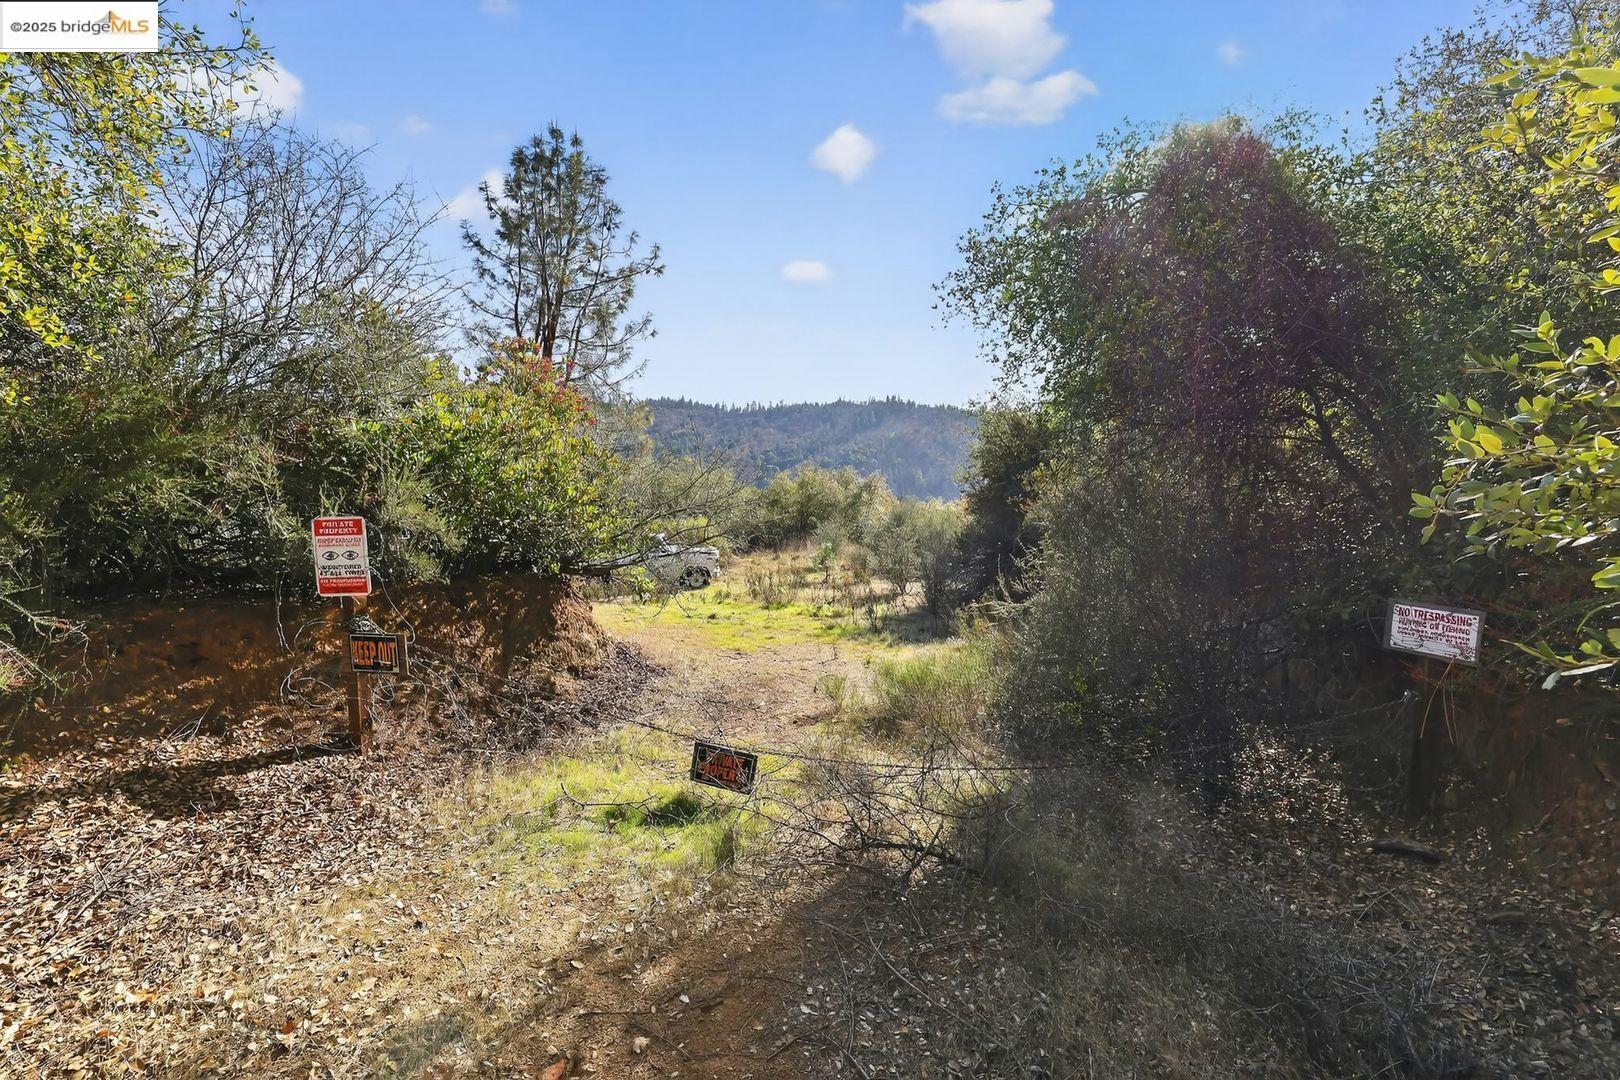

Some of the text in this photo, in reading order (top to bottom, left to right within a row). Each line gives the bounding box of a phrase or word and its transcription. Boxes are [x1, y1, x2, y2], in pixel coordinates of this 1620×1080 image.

[1398, 606, 1473, 627] NO TRESPASSING
[352, 641, 396, 667] KEEP OUT
